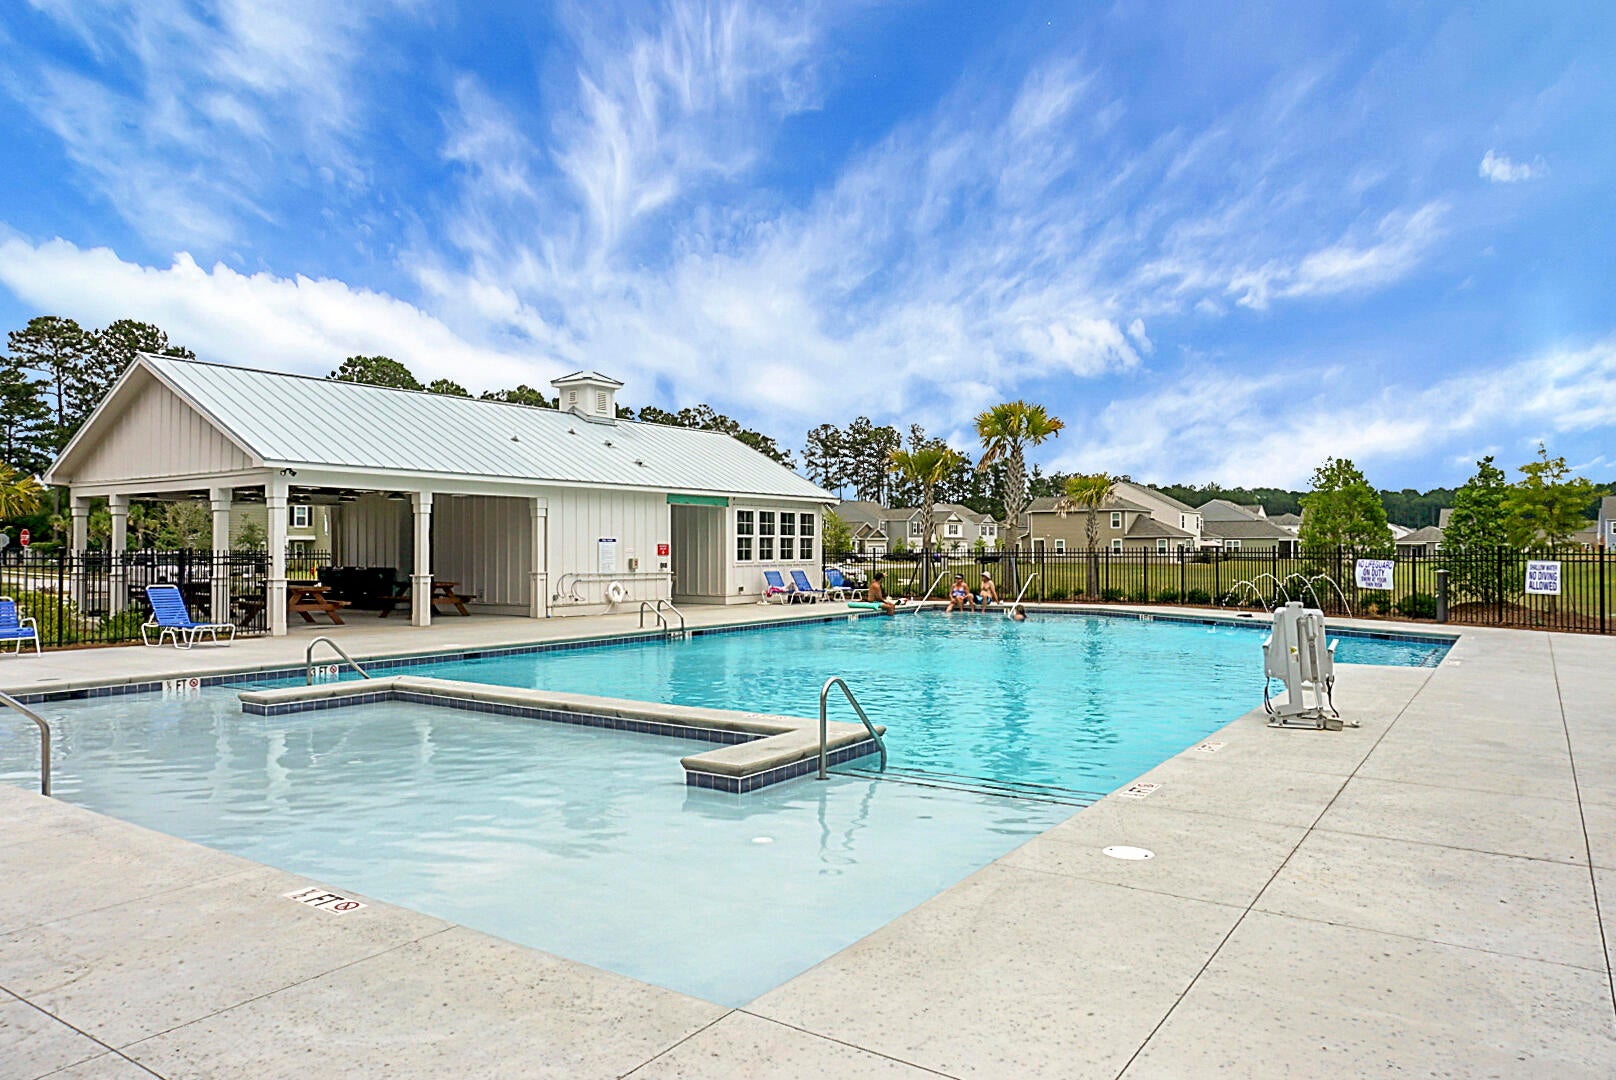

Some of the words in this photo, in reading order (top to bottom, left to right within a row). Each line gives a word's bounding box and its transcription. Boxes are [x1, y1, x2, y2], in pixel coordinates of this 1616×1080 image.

[1358, 560, 1365, 568] NO
[1365, 560, 1393, 570] LIFEGUARD
[1363, 568, 1370, 576] ON
[1371, 568, 1385, 577] DUTY
[1529, 571, 1536, 580] NO
[1538, 571, 1557, 581] DIVING
[1528, 580, 1557, 591] ALLOWED
[319, 666, 328, 676] FT
[176, 679, 187, 690] FT
[303, 894, 345, 907] FT
